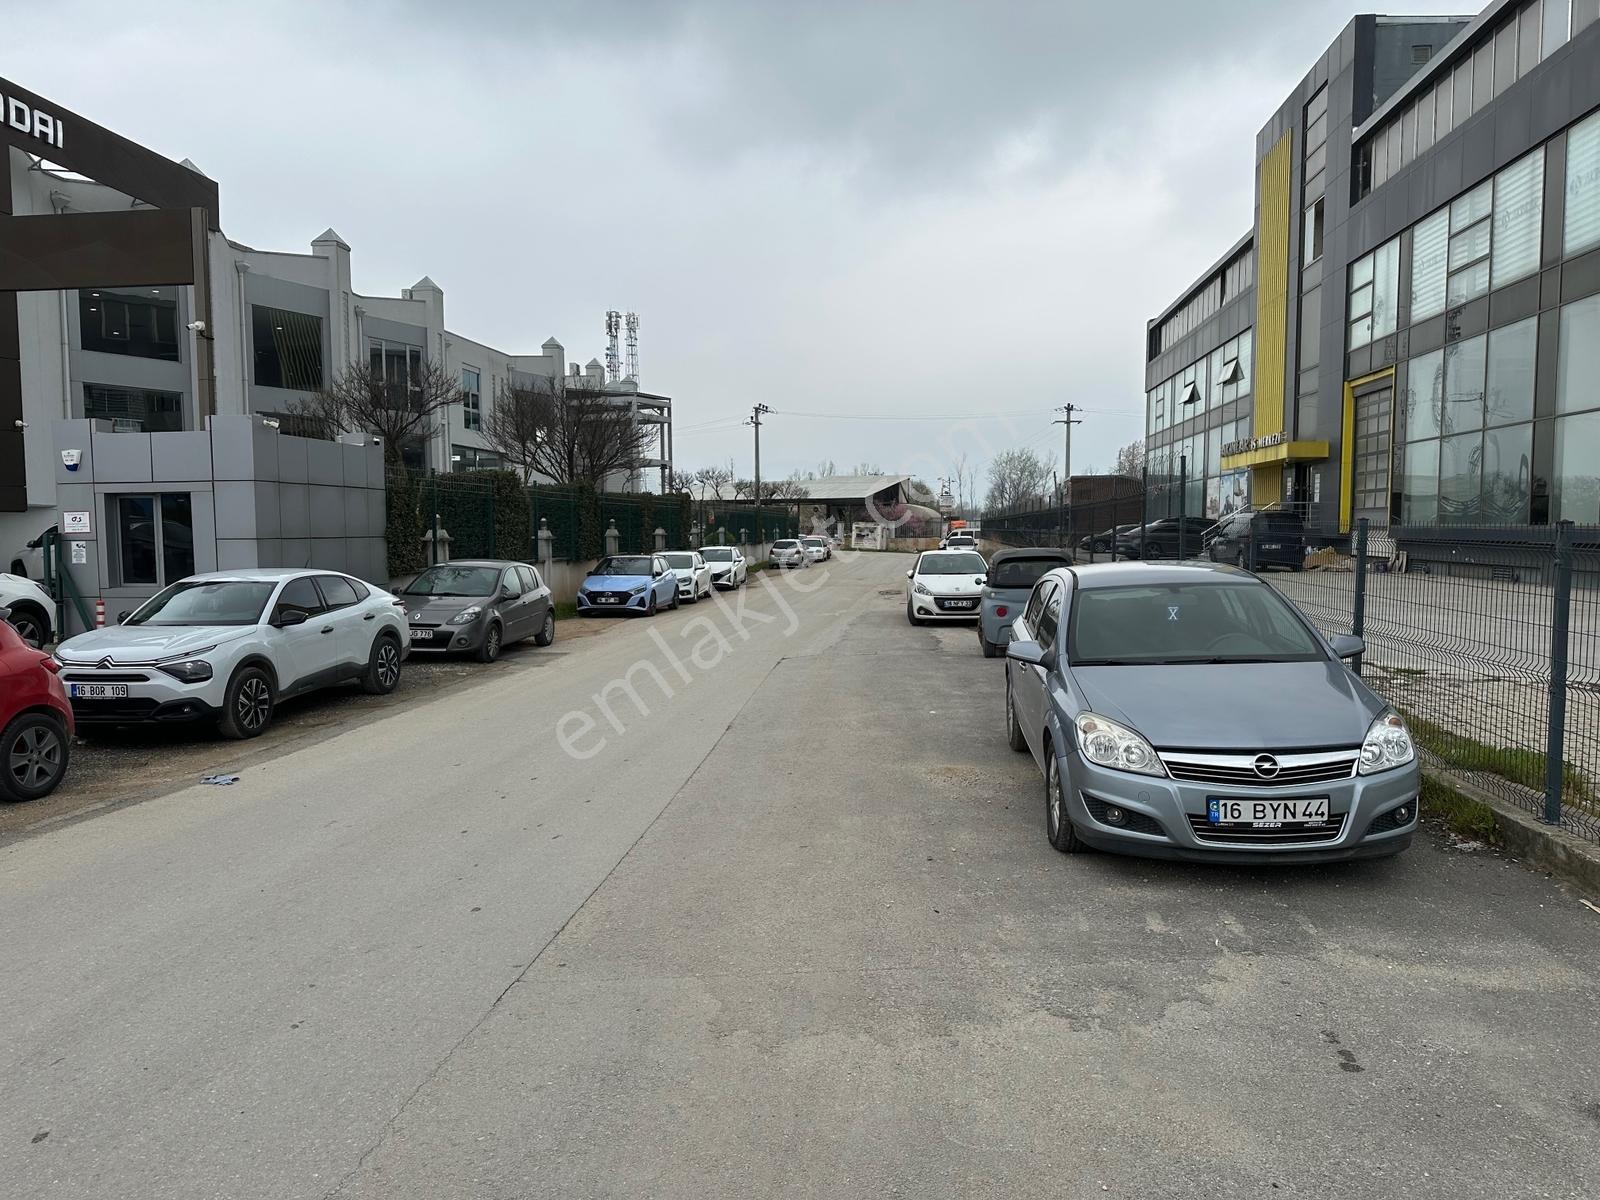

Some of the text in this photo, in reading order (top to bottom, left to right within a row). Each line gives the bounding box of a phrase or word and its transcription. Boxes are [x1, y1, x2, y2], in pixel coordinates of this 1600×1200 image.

[0, 92, 63, 148] DAI
[77, 685, 126, 696] 16 BOR 109
[1221, 801, 1325, 819] 16 BYN 44
